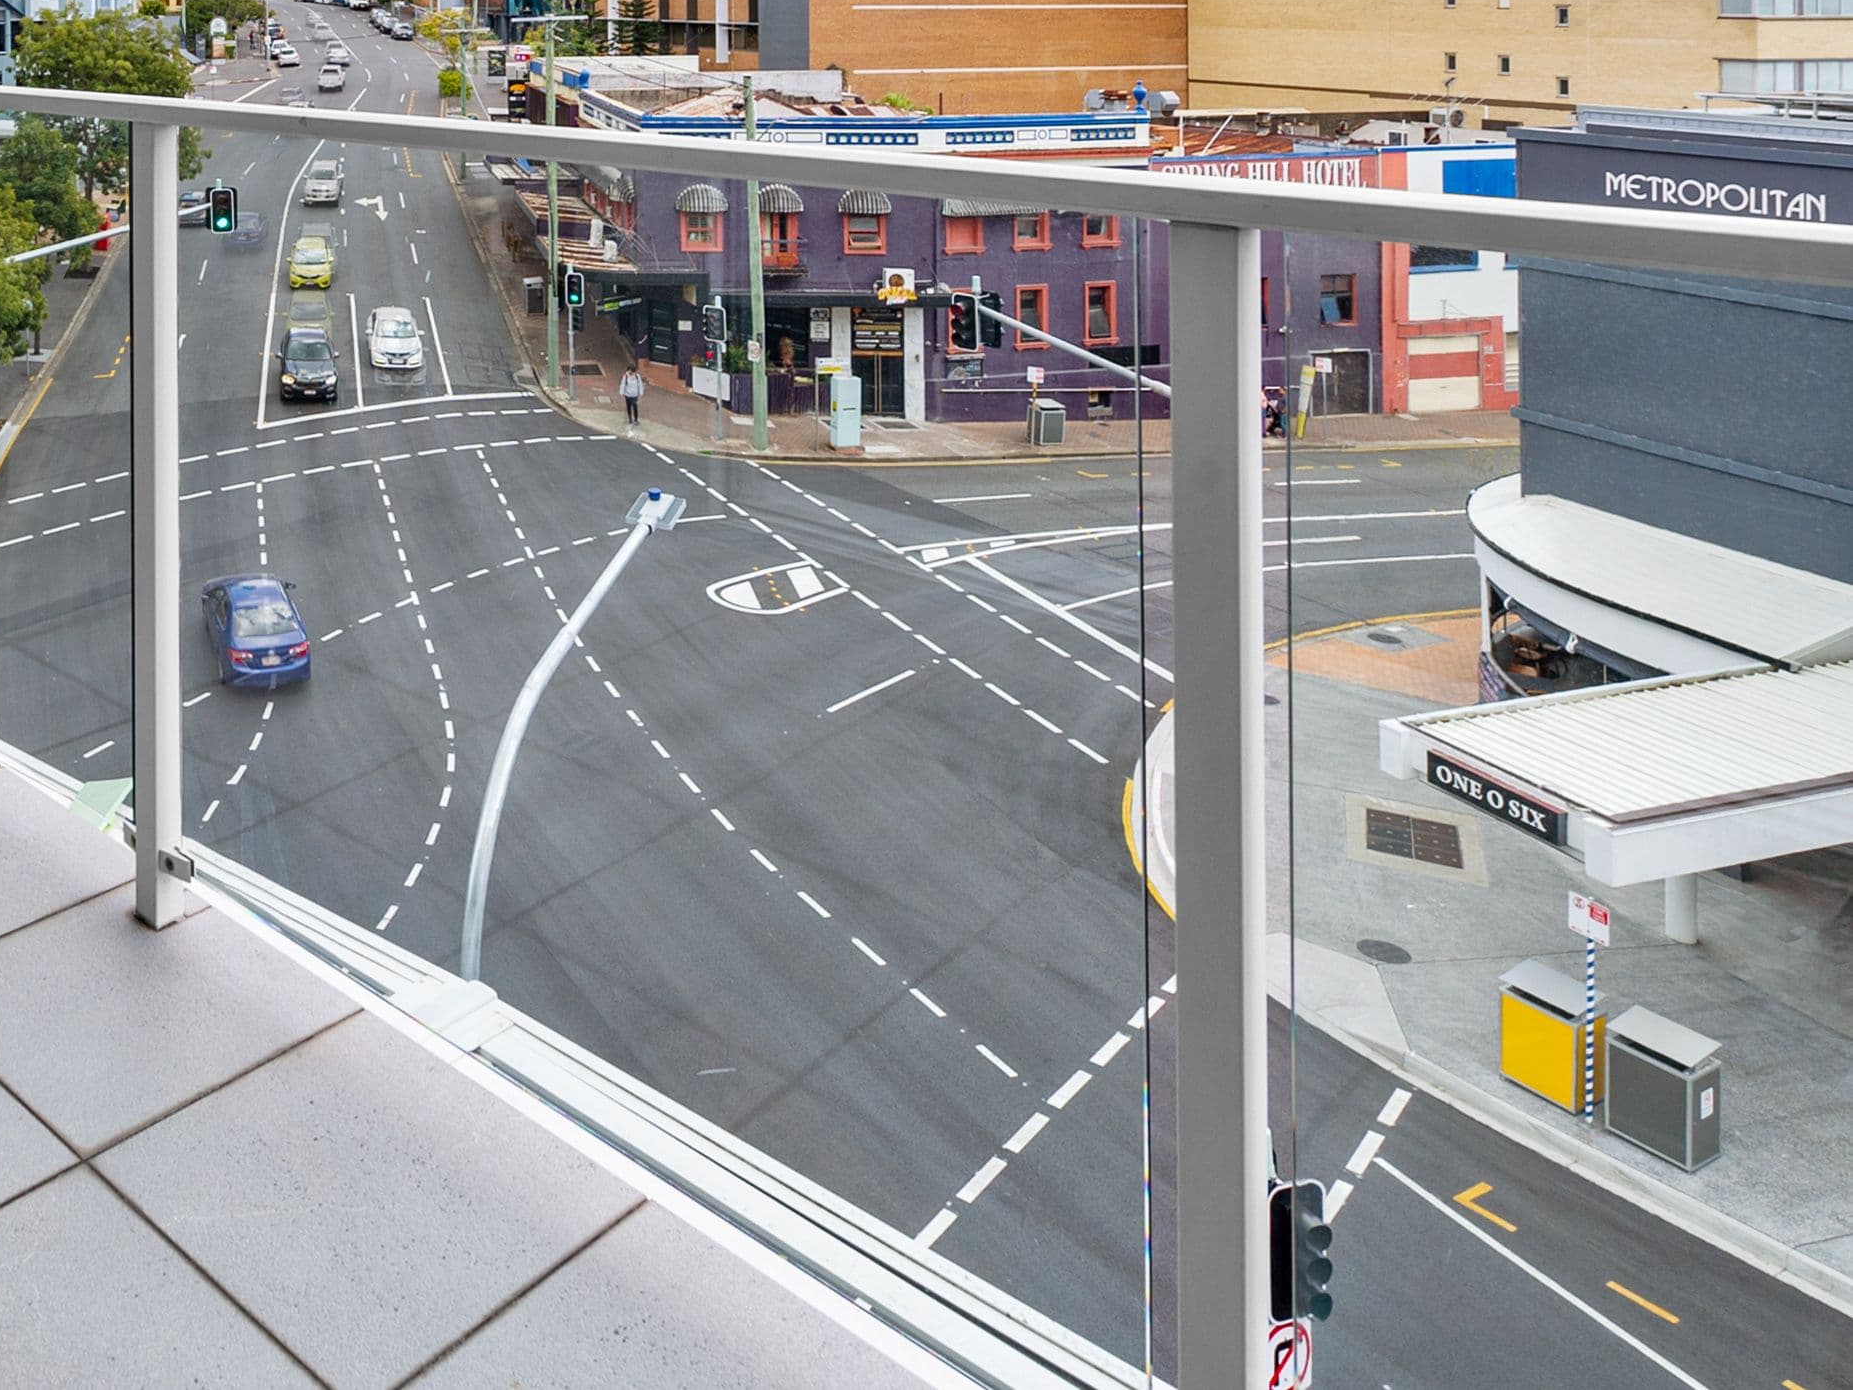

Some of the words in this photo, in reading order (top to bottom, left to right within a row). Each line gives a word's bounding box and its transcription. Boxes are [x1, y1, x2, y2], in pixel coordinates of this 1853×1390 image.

[1161, 162, 1241, 178] ING
[1302, 159, 1367, 188] HOTEL
[1605, 171, 1827, 222] METROPOLITAN
[1435, 764, 1483, 800] ONE
[1486, 789, 1504, 809] O
[1507, 798, 1546, 832] SIX
